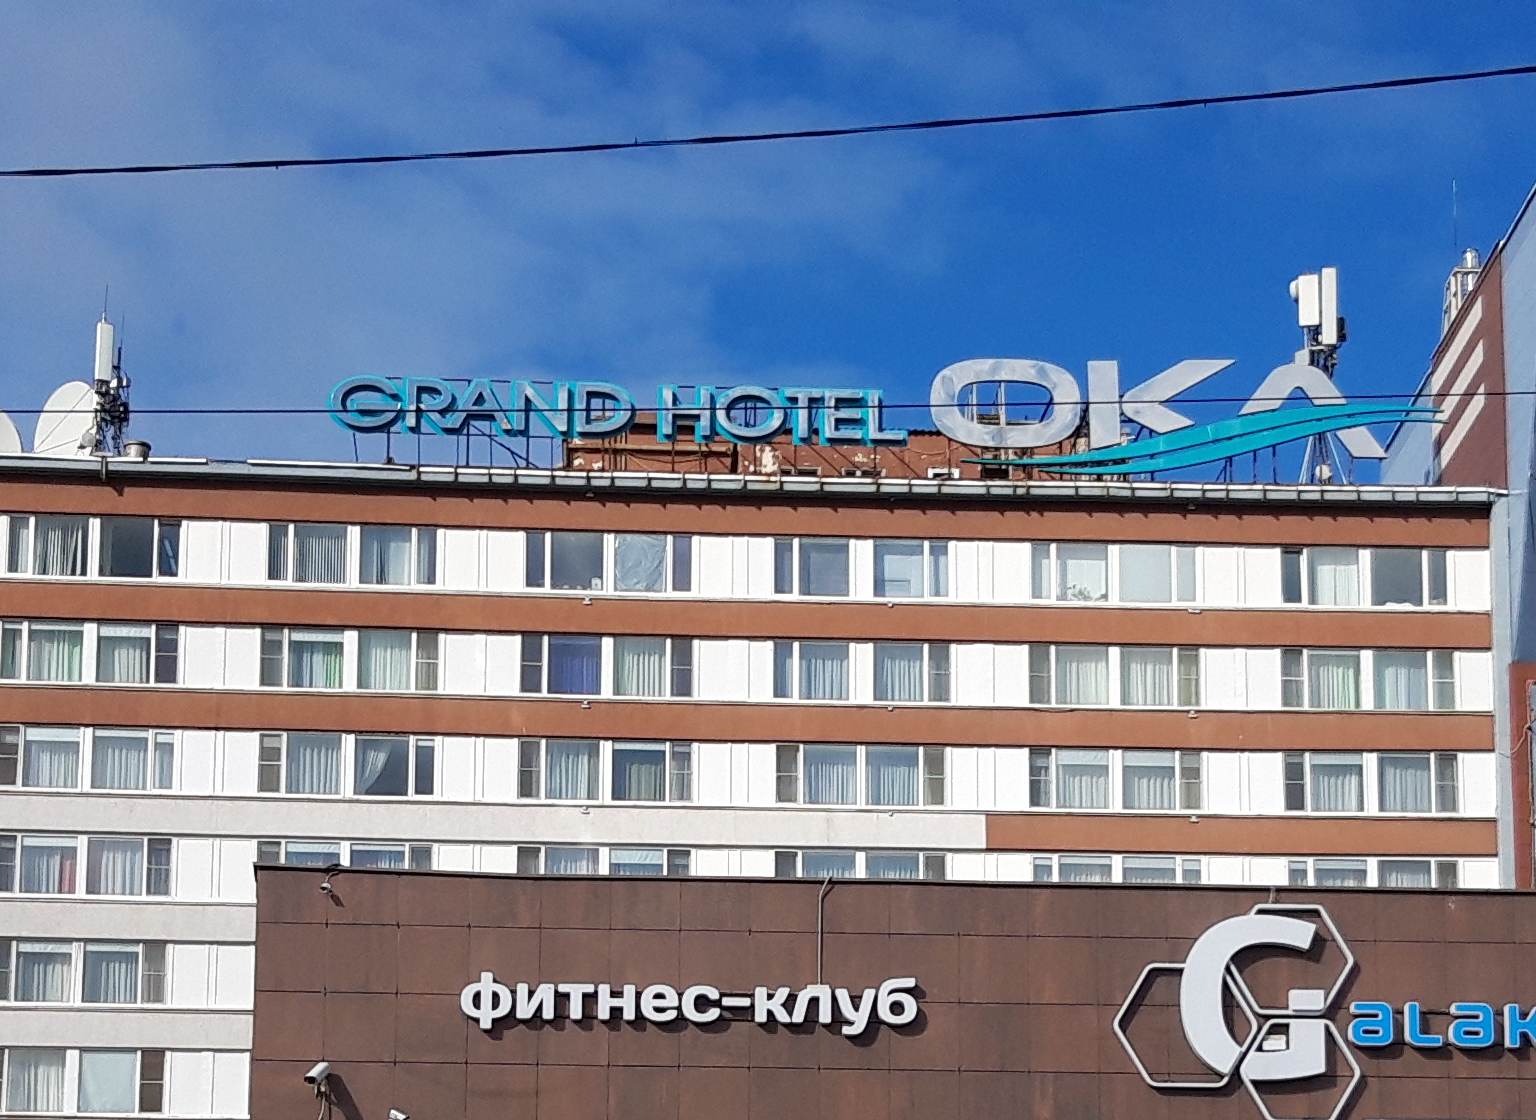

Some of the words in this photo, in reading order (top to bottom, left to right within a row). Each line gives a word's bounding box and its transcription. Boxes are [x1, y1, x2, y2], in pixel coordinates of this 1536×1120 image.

[331, 376, 635, 435] GRAND
[657, 385, 906, 445] HOTEL
[929, 360, 1387, 457] OKA
[460, 972, 917, 1034] фитнес-клуб
